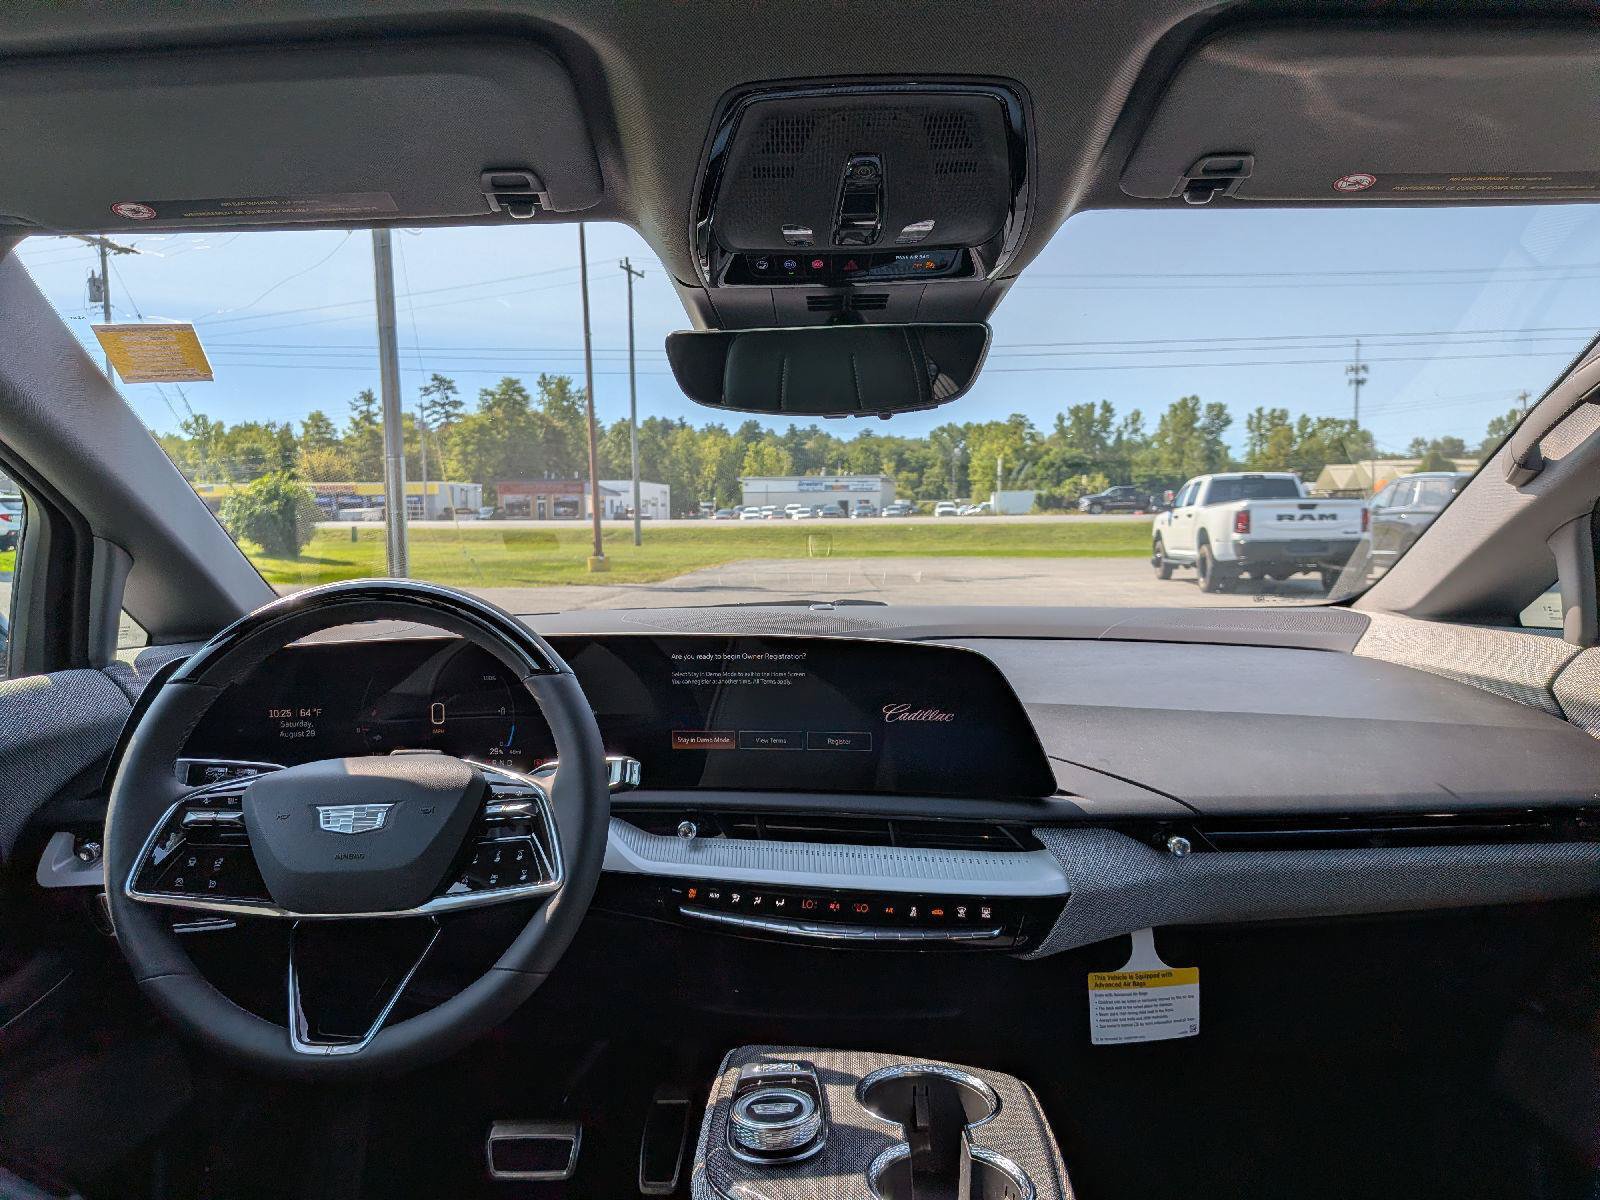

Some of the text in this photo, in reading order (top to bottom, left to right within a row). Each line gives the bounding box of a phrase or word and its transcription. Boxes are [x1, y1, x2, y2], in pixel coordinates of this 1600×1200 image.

[1276, 513, 1338, 521] RAM
[696, 653, 714, 661] ready
[723, 652, 741, 661] begin
[742, 652, 764, 660] Owner
[765, 652, 807, 661] Registration?
[300, 708, 311, 717] 64
[431, 702, 446, 725] 0
[882, 703, 955, 723] Cadillac
[280, 719, 314, 729] Saturday,
[279, 730, 305, 739] August
[677, 736, 690, 745] Stay
[827, 738, 851, 746] Register
[802, 900, 814, 909] LO
[1107, 973, 1127, 981] Vehicle
[1134, 972, 1160, 982] Equipped
[1160, 971, 1173, 979] with
[1132, 980, 1146, 988] Bags
